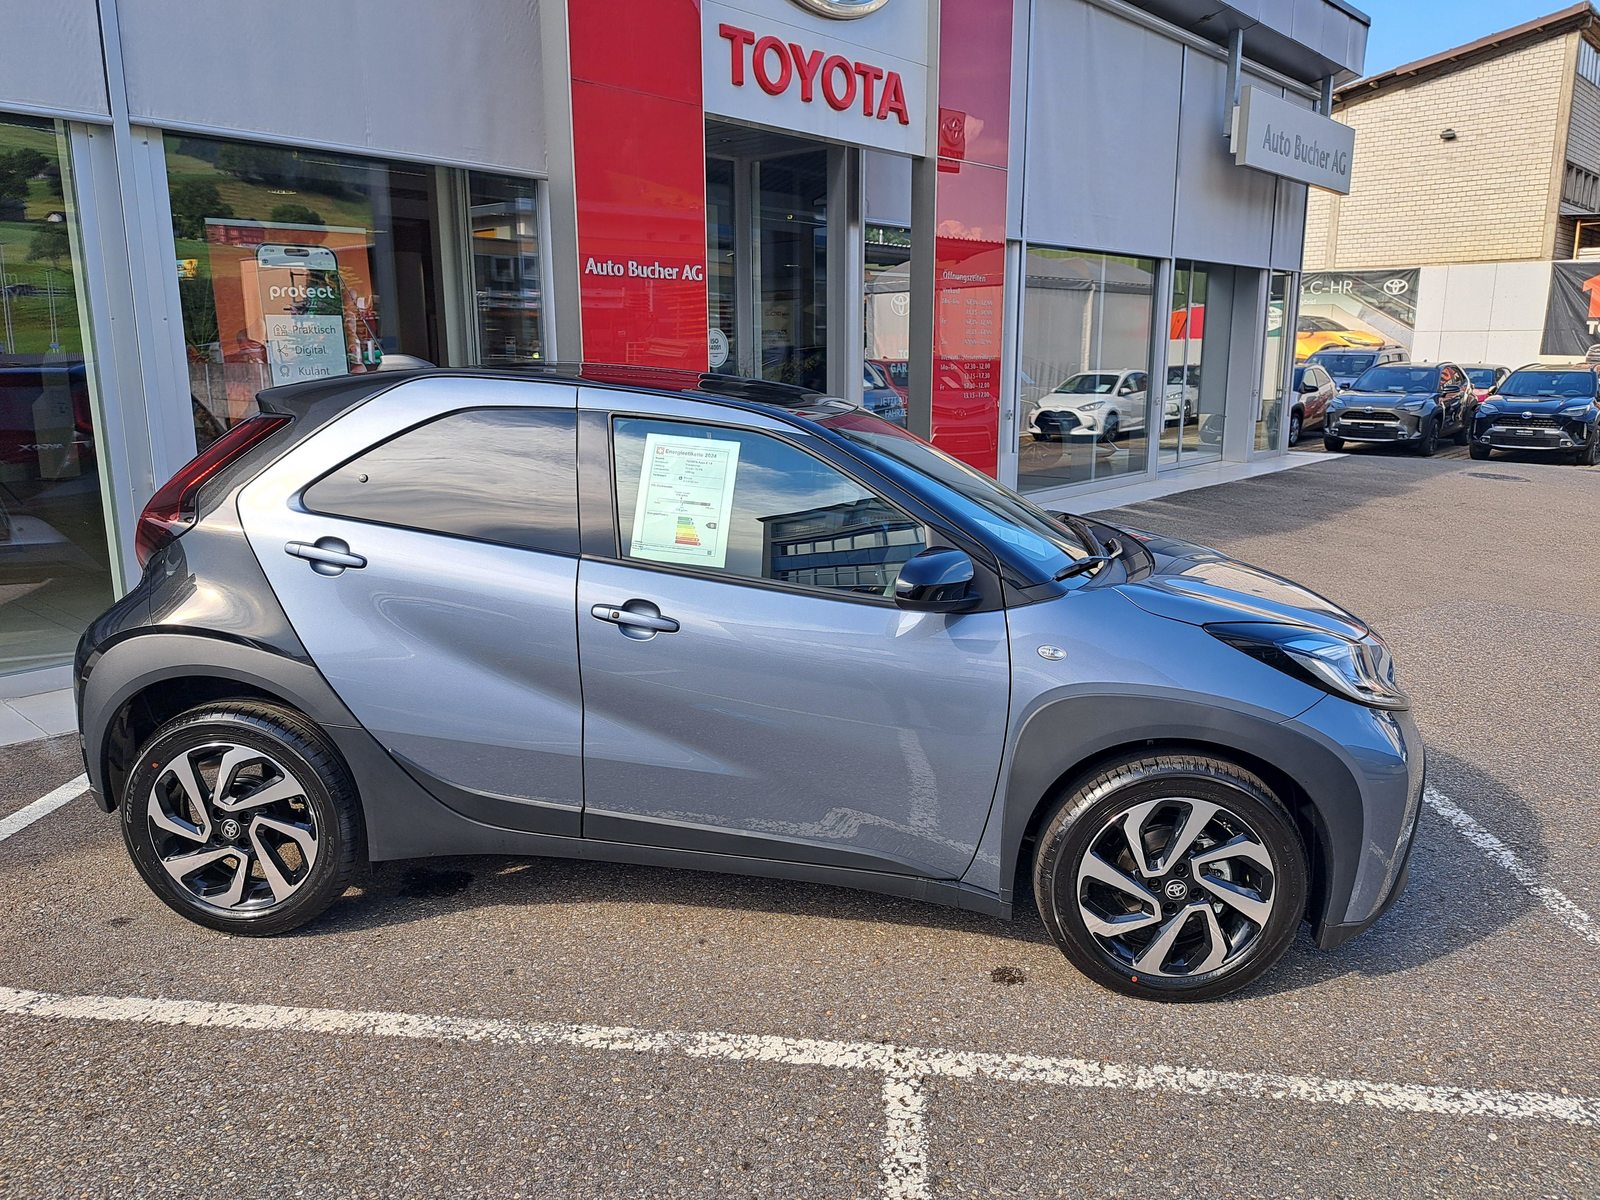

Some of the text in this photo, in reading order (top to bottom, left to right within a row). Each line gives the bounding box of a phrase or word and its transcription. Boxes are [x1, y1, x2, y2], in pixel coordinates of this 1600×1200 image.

[718, 23, 909, 126] TOYOTA
[1262, 124, 1347, 176] Auto Bucher AG
[585, 257, 703, 282] Auto Bucher AG
[269, 285, 335, 301] protect
[1310, 280, 1353, 295] C-HR
[292, 324, 336, 335] Praktisch
[295, 345, 327, 357] Digital
[298, 366, 331, 377] Kulant
